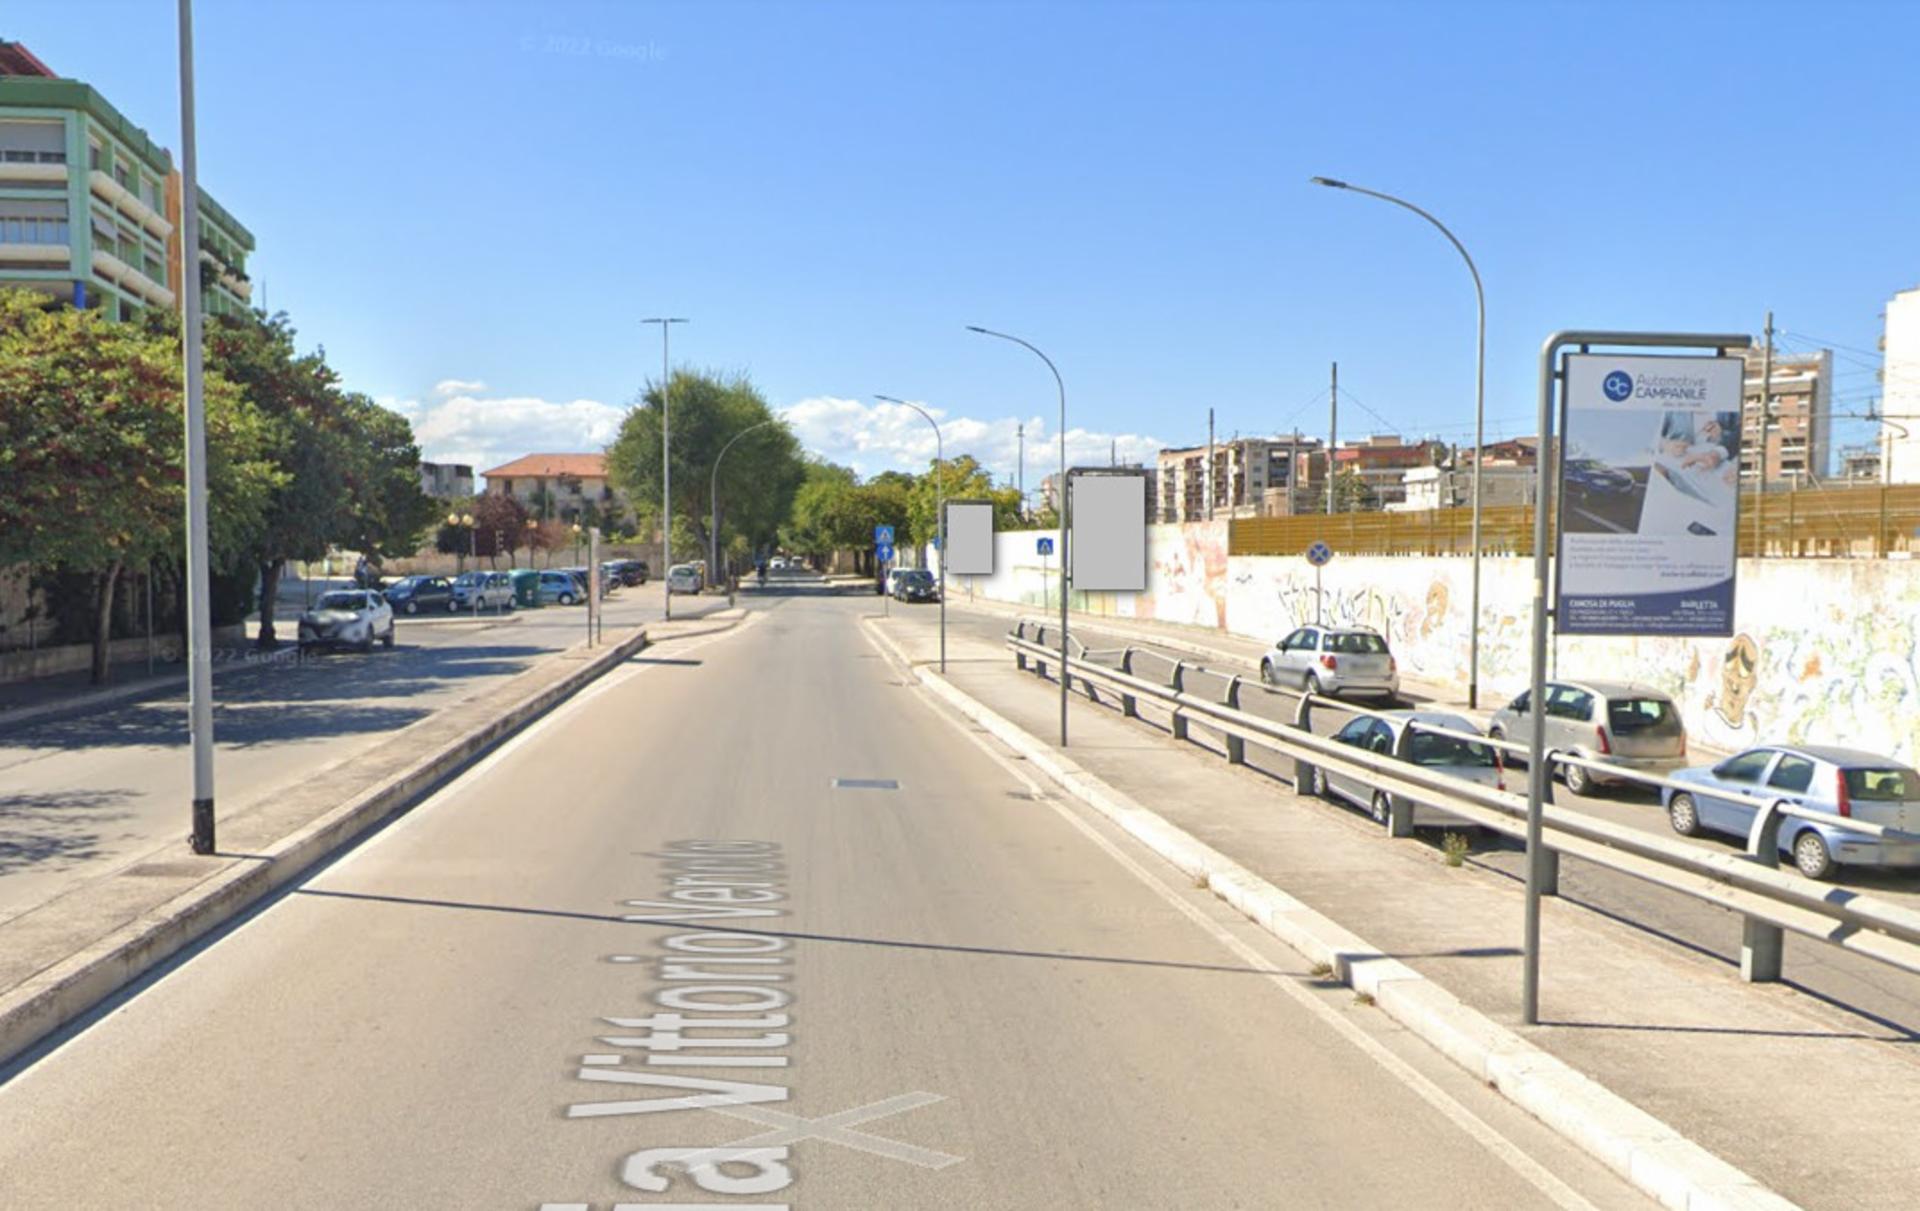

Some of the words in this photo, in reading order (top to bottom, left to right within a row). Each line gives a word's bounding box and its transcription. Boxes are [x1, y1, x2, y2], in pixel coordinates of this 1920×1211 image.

[1636, 373, 1708, 387] Automotive
[1635, 387, 1708, 401] CAMPANILE
[1680, 600, 1719, 609] BARLETTA
